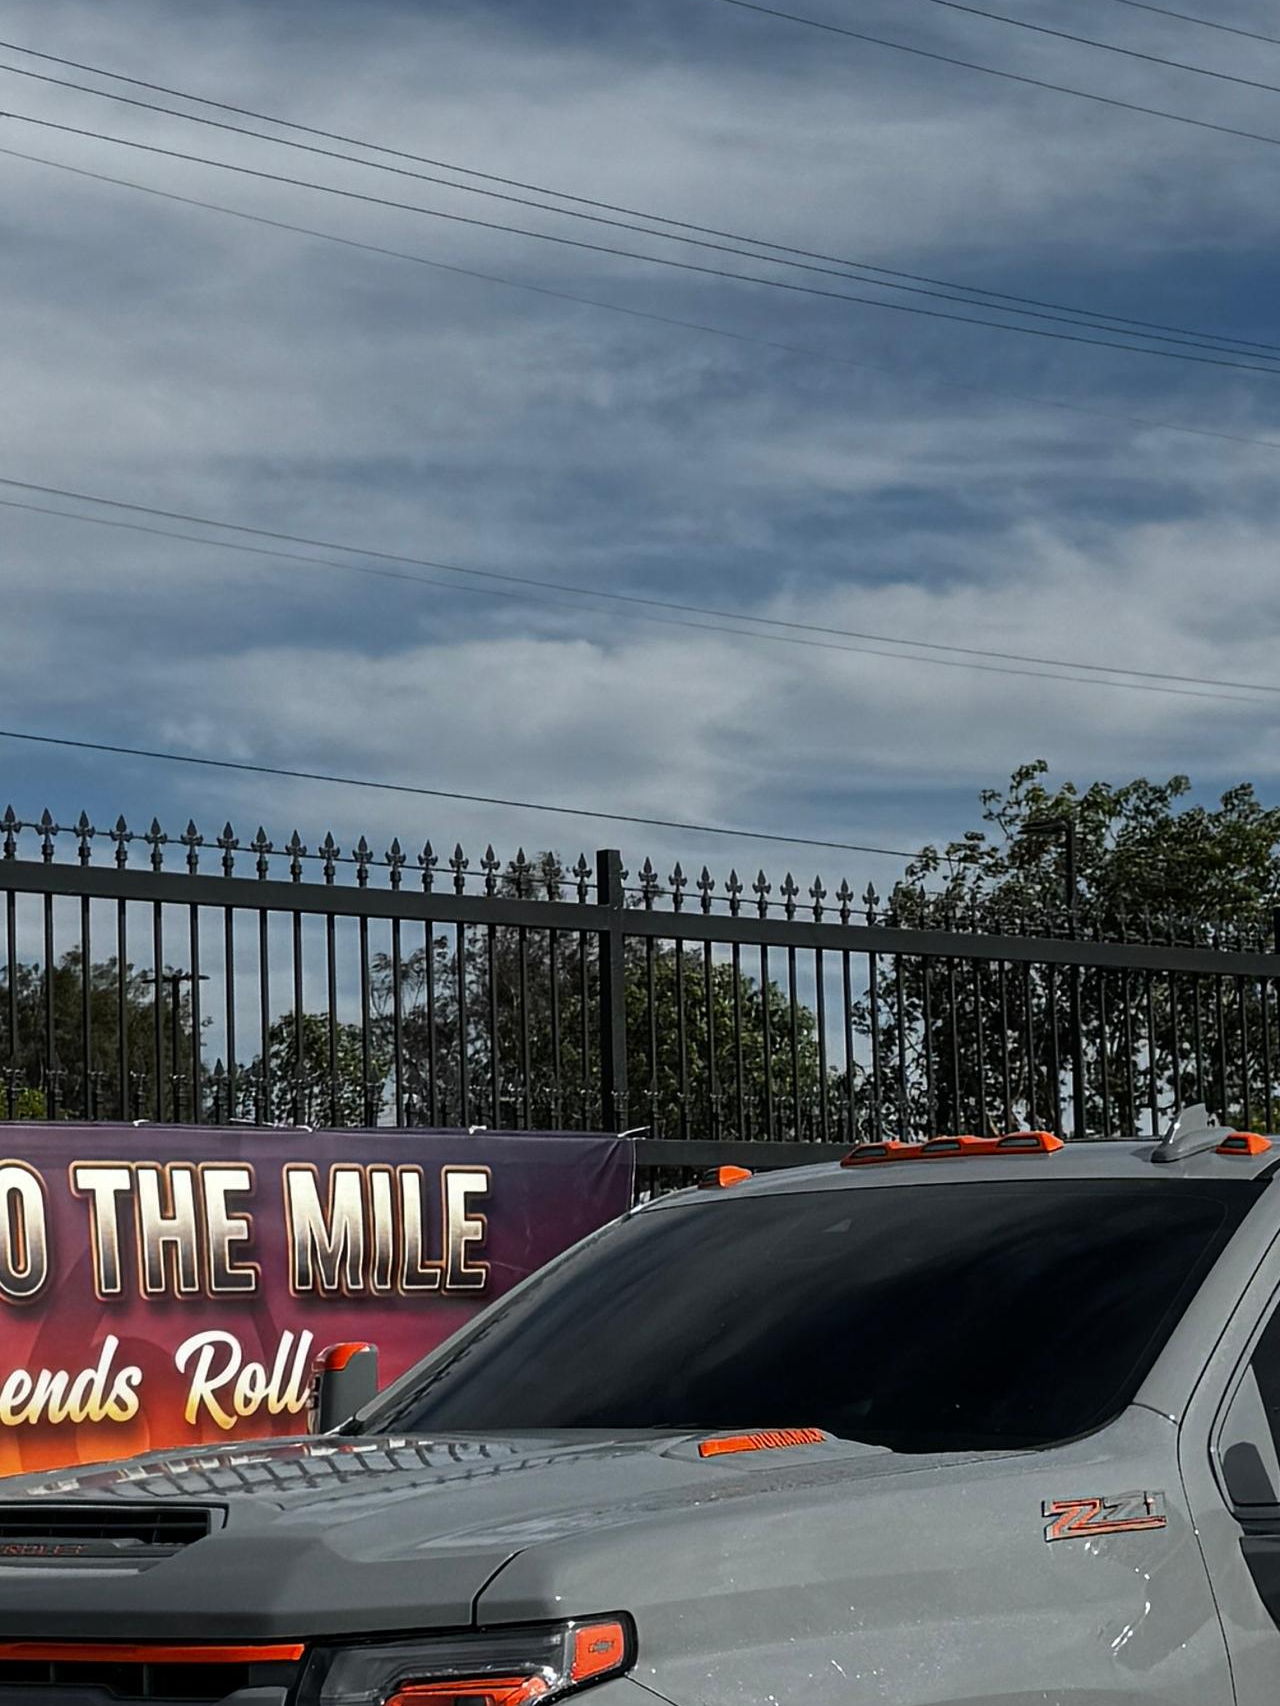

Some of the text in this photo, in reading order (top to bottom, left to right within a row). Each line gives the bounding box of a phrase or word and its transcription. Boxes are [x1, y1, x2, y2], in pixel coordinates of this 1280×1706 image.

[70, 1159, 260, 1303] THE
[282, 1162, 491, 1301] MILE
[174, 1329, 314, 1431] Roll
